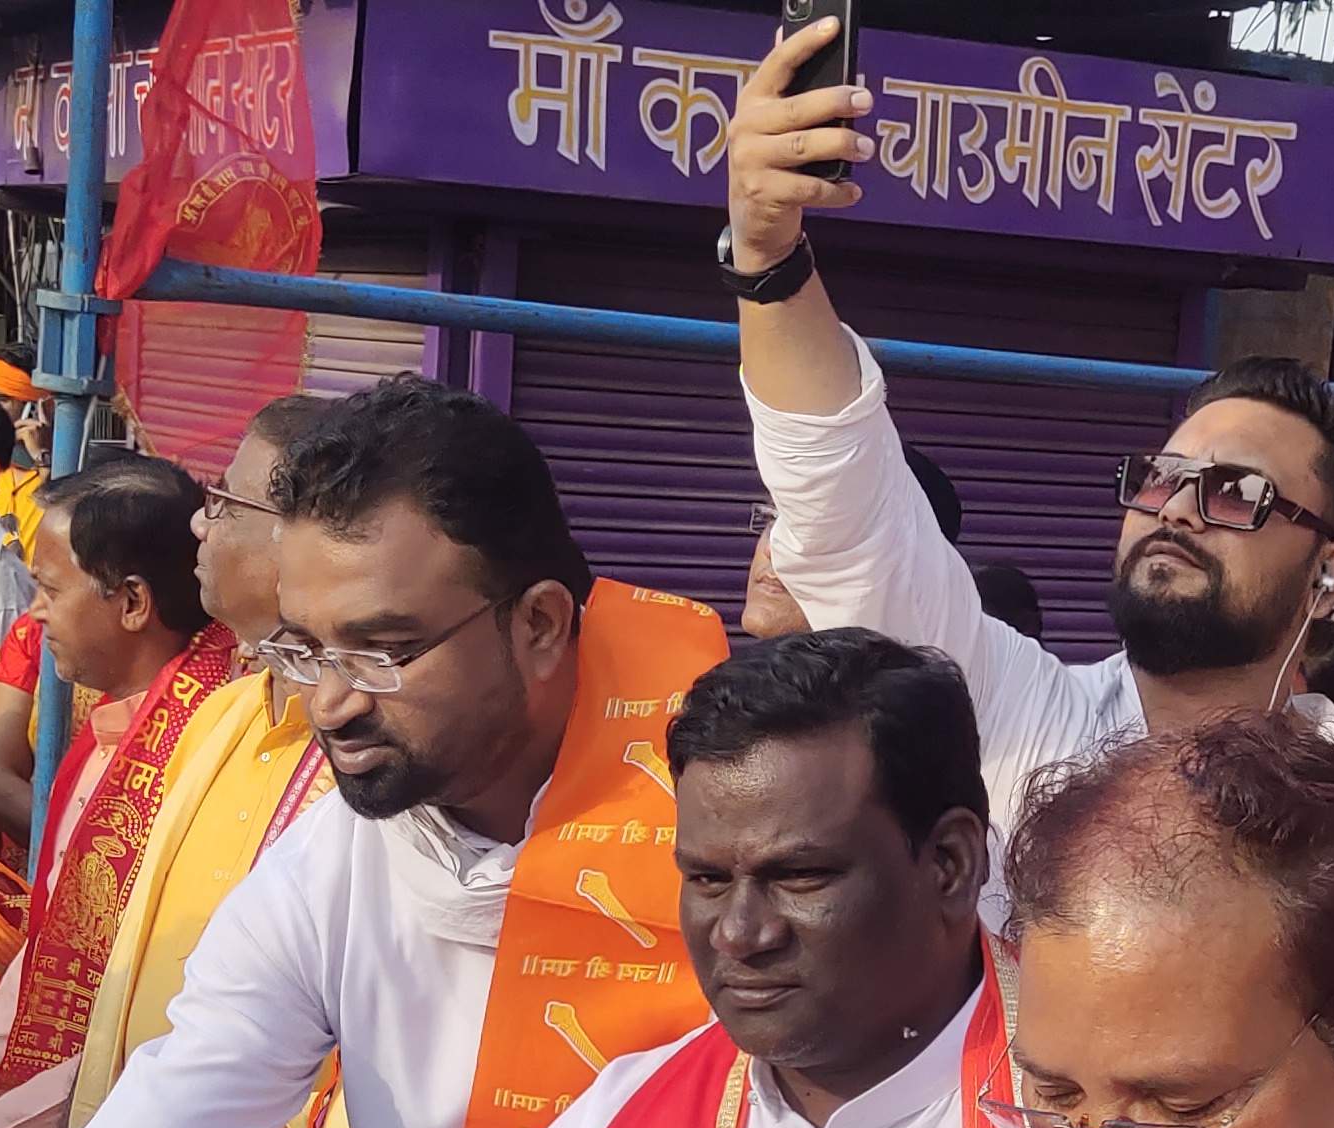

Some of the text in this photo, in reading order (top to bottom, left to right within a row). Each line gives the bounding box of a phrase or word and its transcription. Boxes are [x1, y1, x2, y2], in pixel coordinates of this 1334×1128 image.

[489, 0, 623, 171] माँ
[876, 56, 1132, 215] चाउमीन
[1136, 71, 1297, 240] सेंटर
